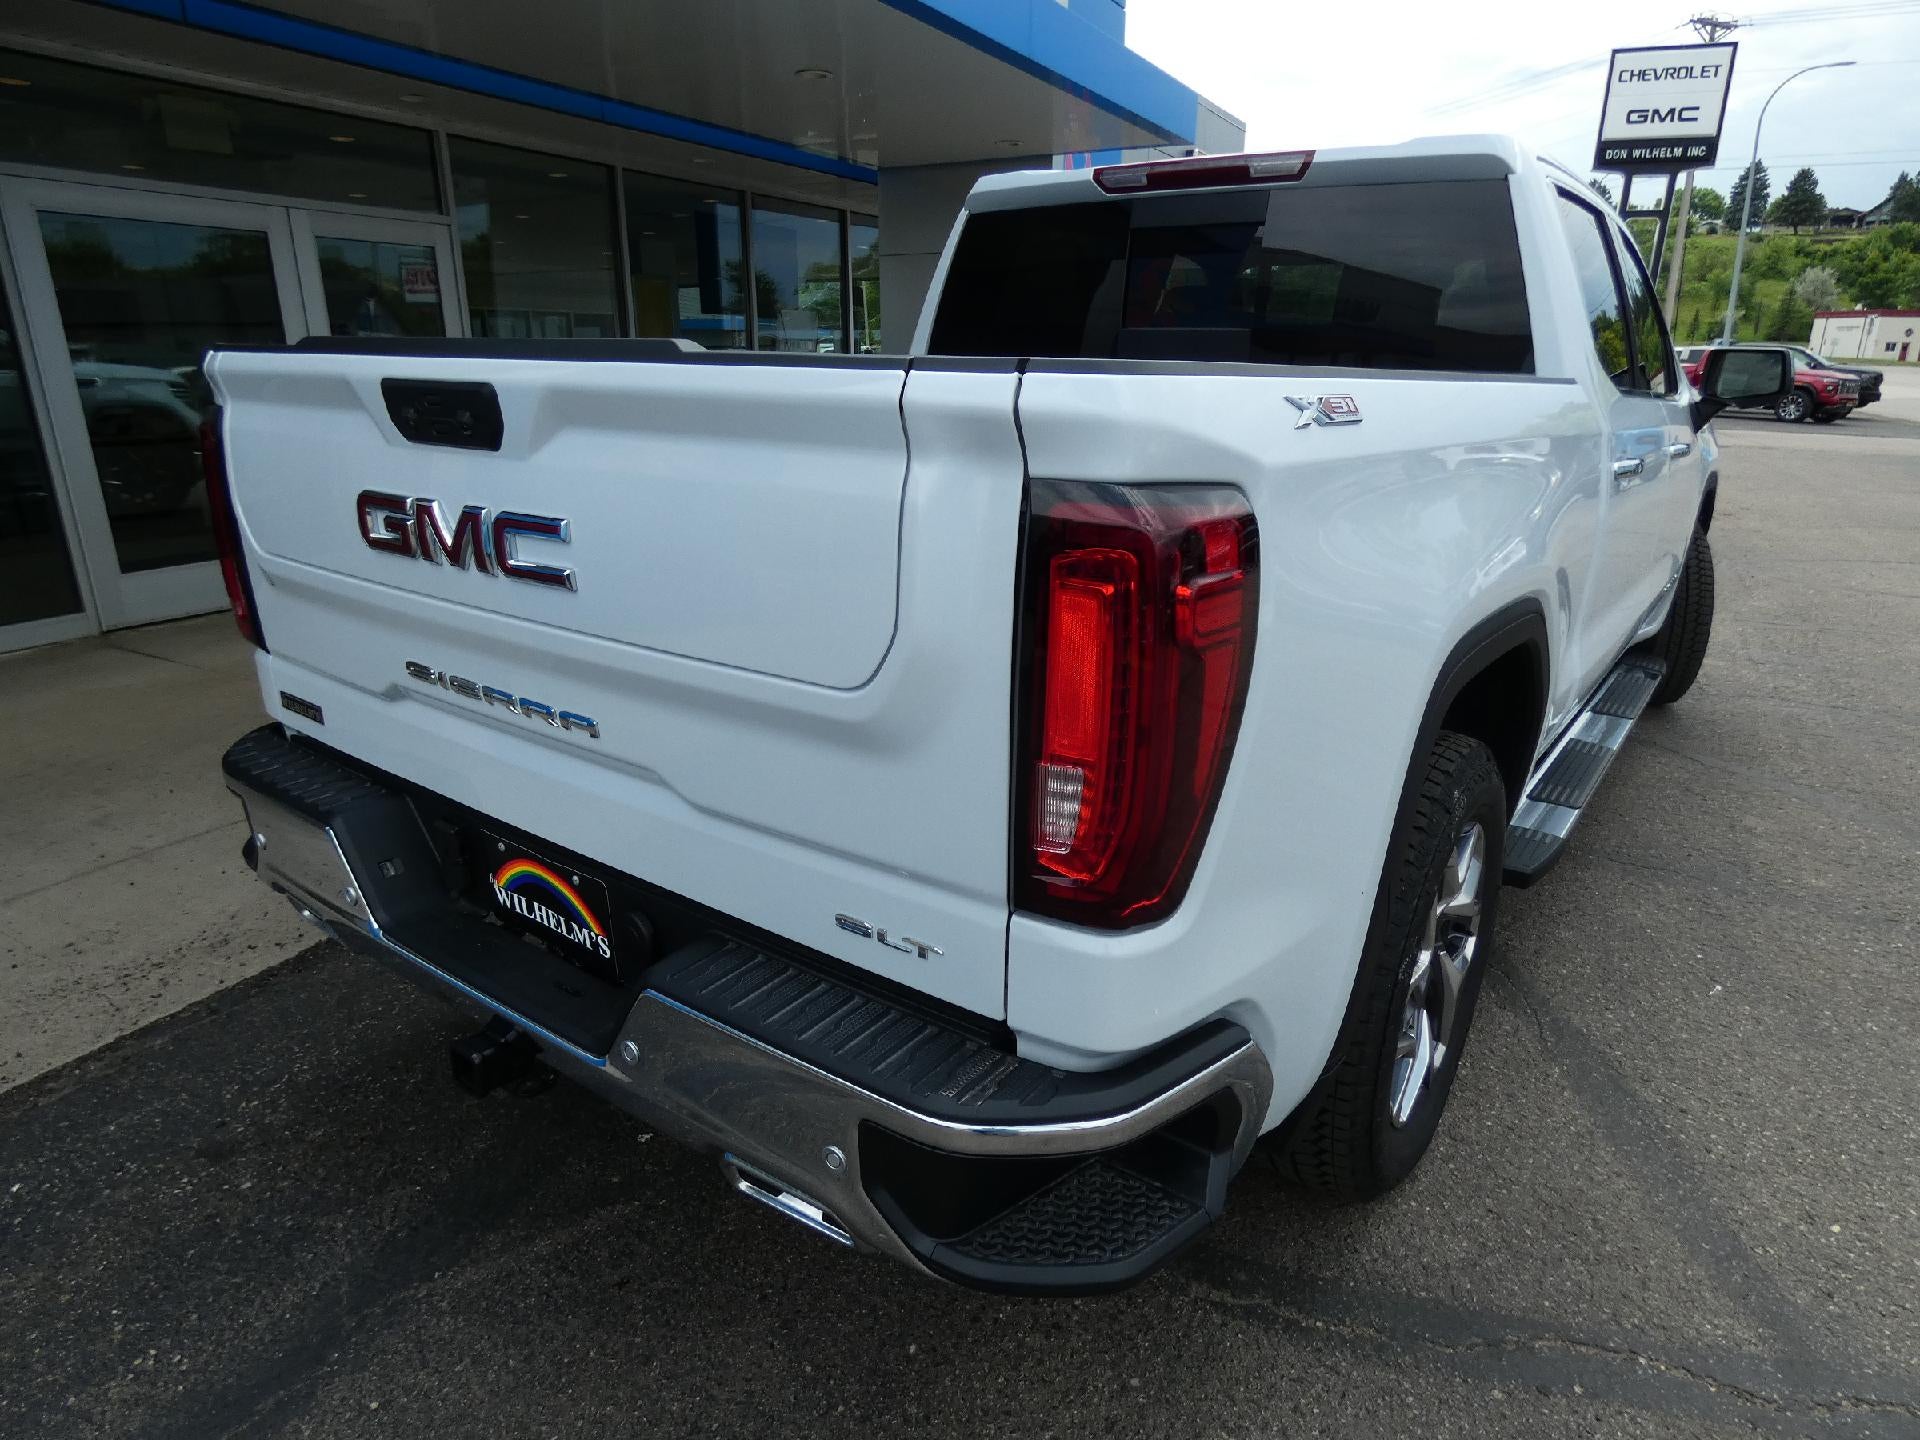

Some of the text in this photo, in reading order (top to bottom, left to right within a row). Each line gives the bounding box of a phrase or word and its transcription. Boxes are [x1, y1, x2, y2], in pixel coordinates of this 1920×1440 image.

[1618, 64, 1723, 82] CHEVROLET
[1626, 106, 1700, 124] GMC
[1605, 145, 1706, 160] DON WILHELM INC
[356, 489, 578, 592] GMC
[405, 661, 600, 739] SIERRA
[494, 886, 610, 959] WILHELM'S
[834, 913, 945, 960] SLT
